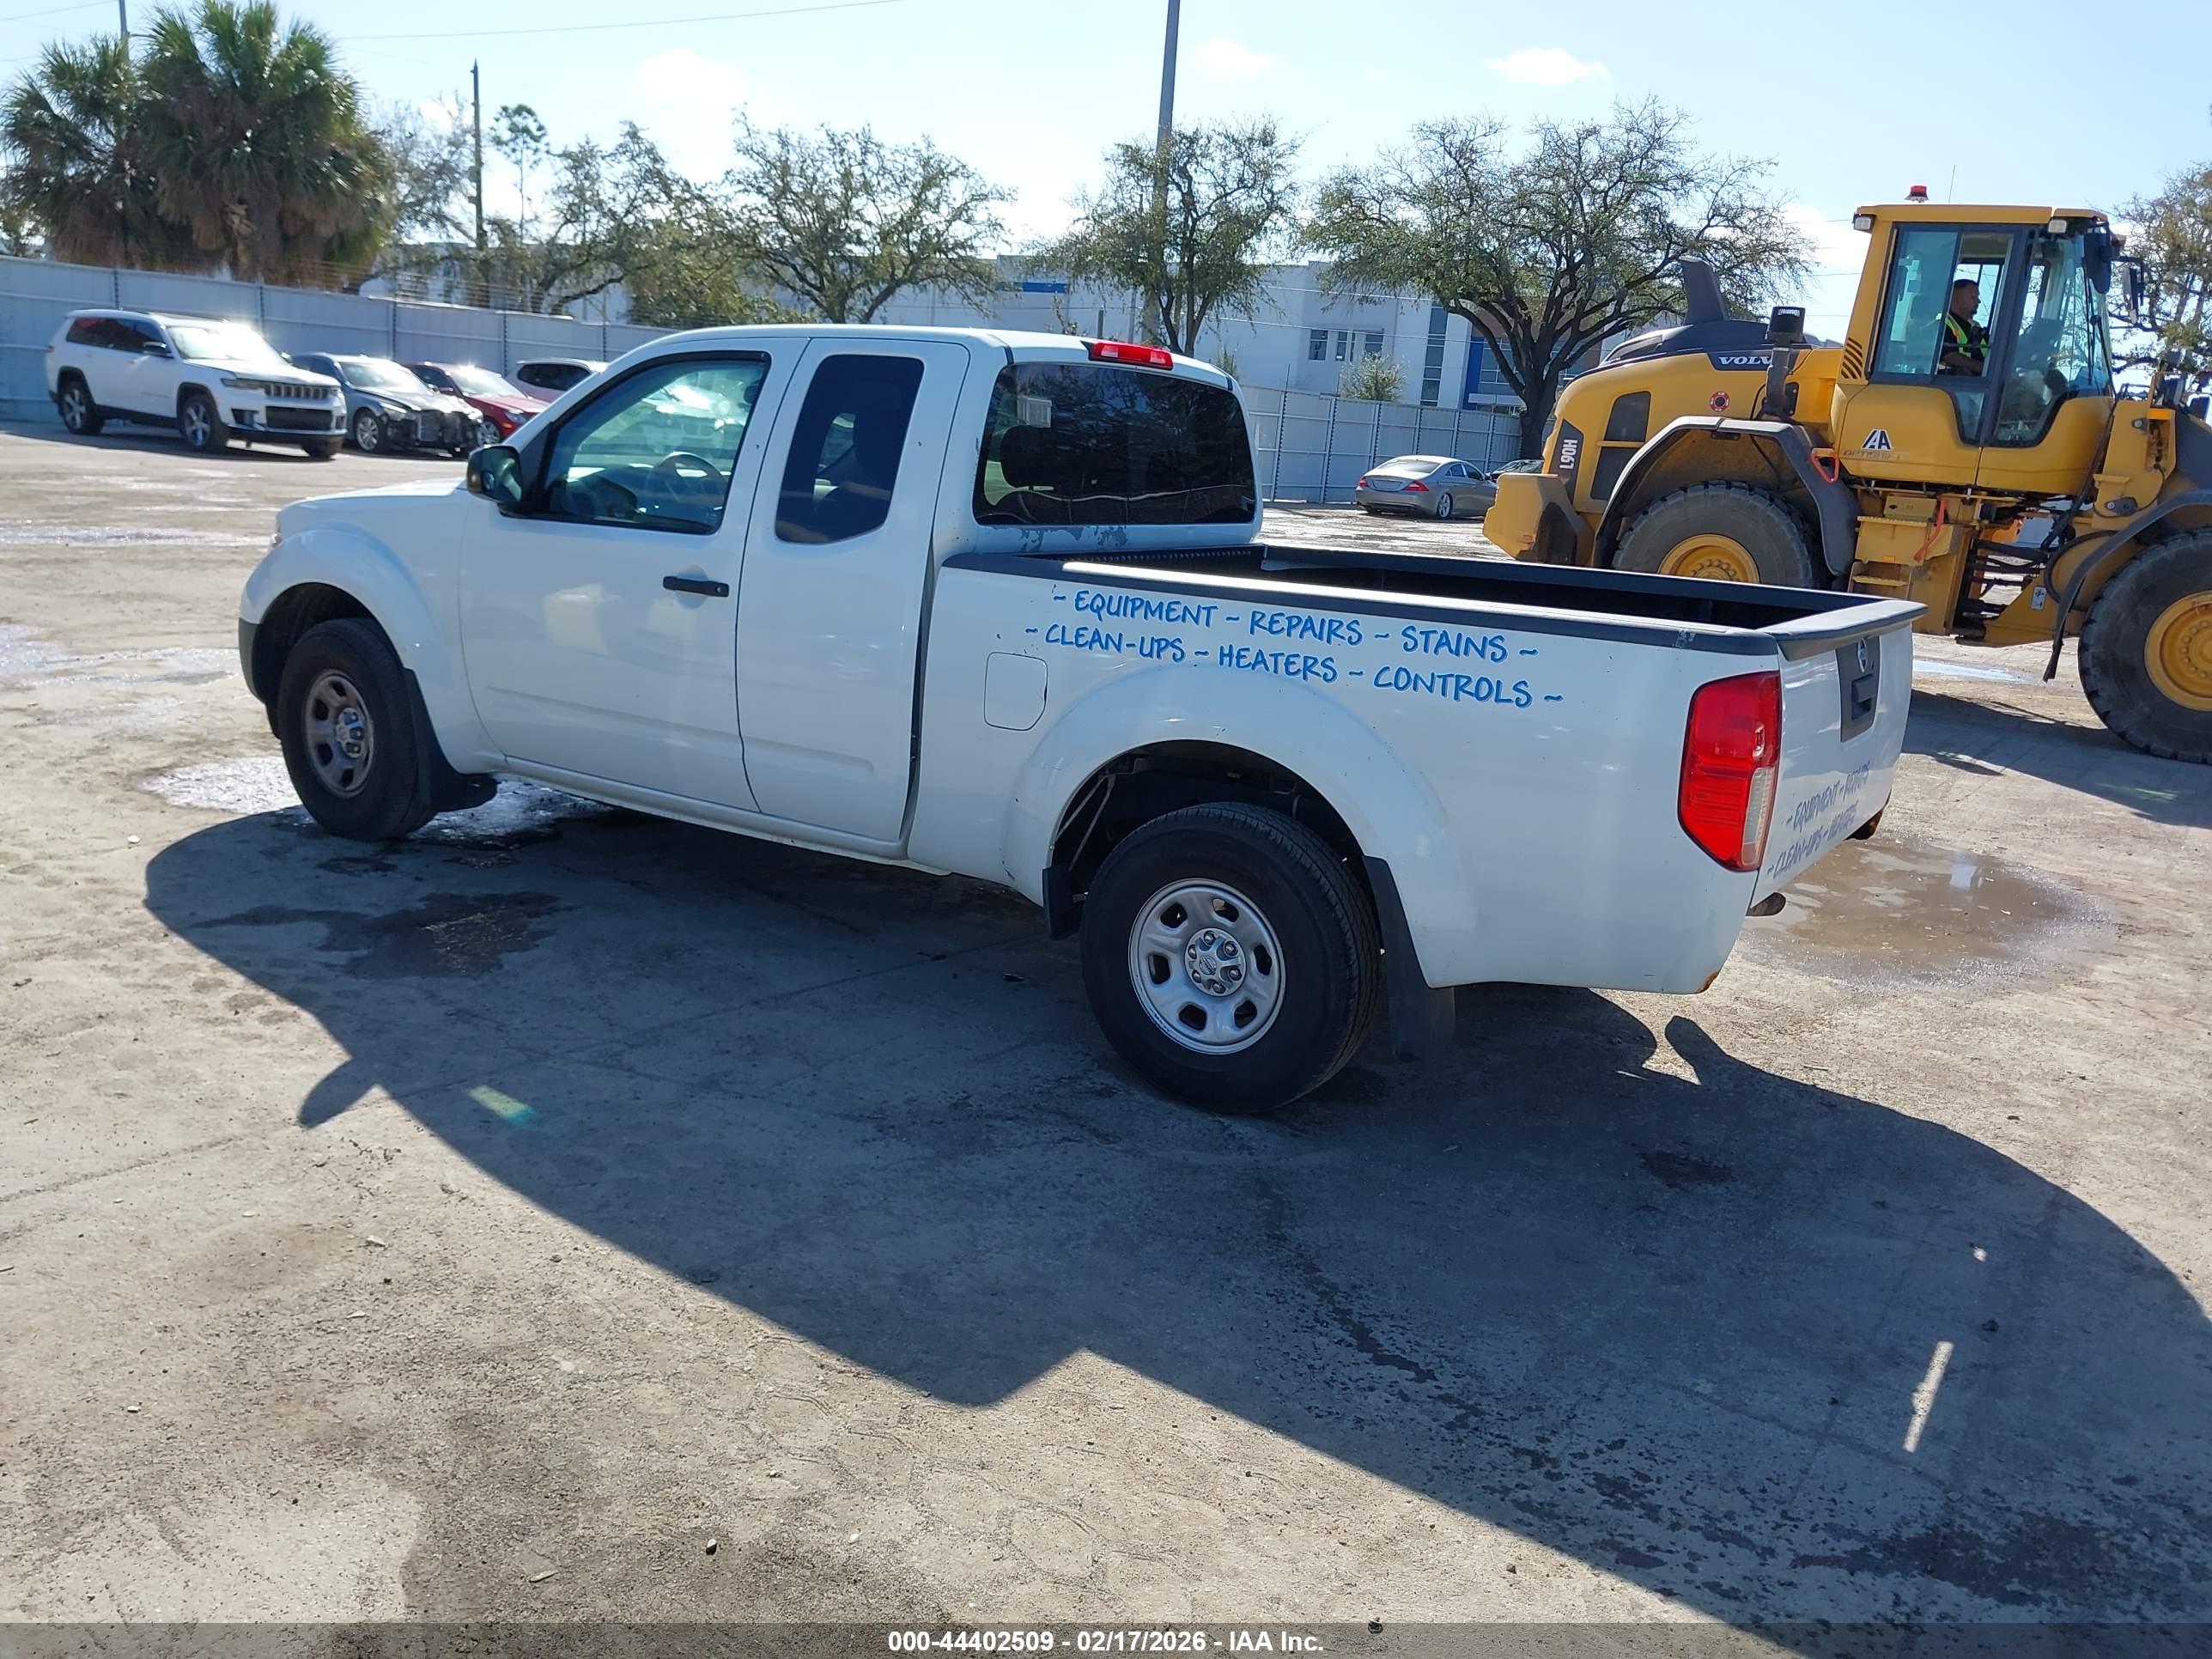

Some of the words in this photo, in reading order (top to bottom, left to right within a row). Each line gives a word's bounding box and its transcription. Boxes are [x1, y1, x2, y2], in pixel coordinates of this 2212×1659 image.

[1717, 356, 1771, 365] VOLV
[1559, 439, 1578, 470] L90H
[1074, 589, 1218, 629] EQUIPMENT
[1249, 610, 1364, 647] REPAIRS
[1401, 624, 1508, 664] STAINS
[1044, 623, 1187, 664] CLEAN-UPS
[1218, 644, 1339, 684] HEATERS
[1373, 665, 1533, 709] CONTROLS
